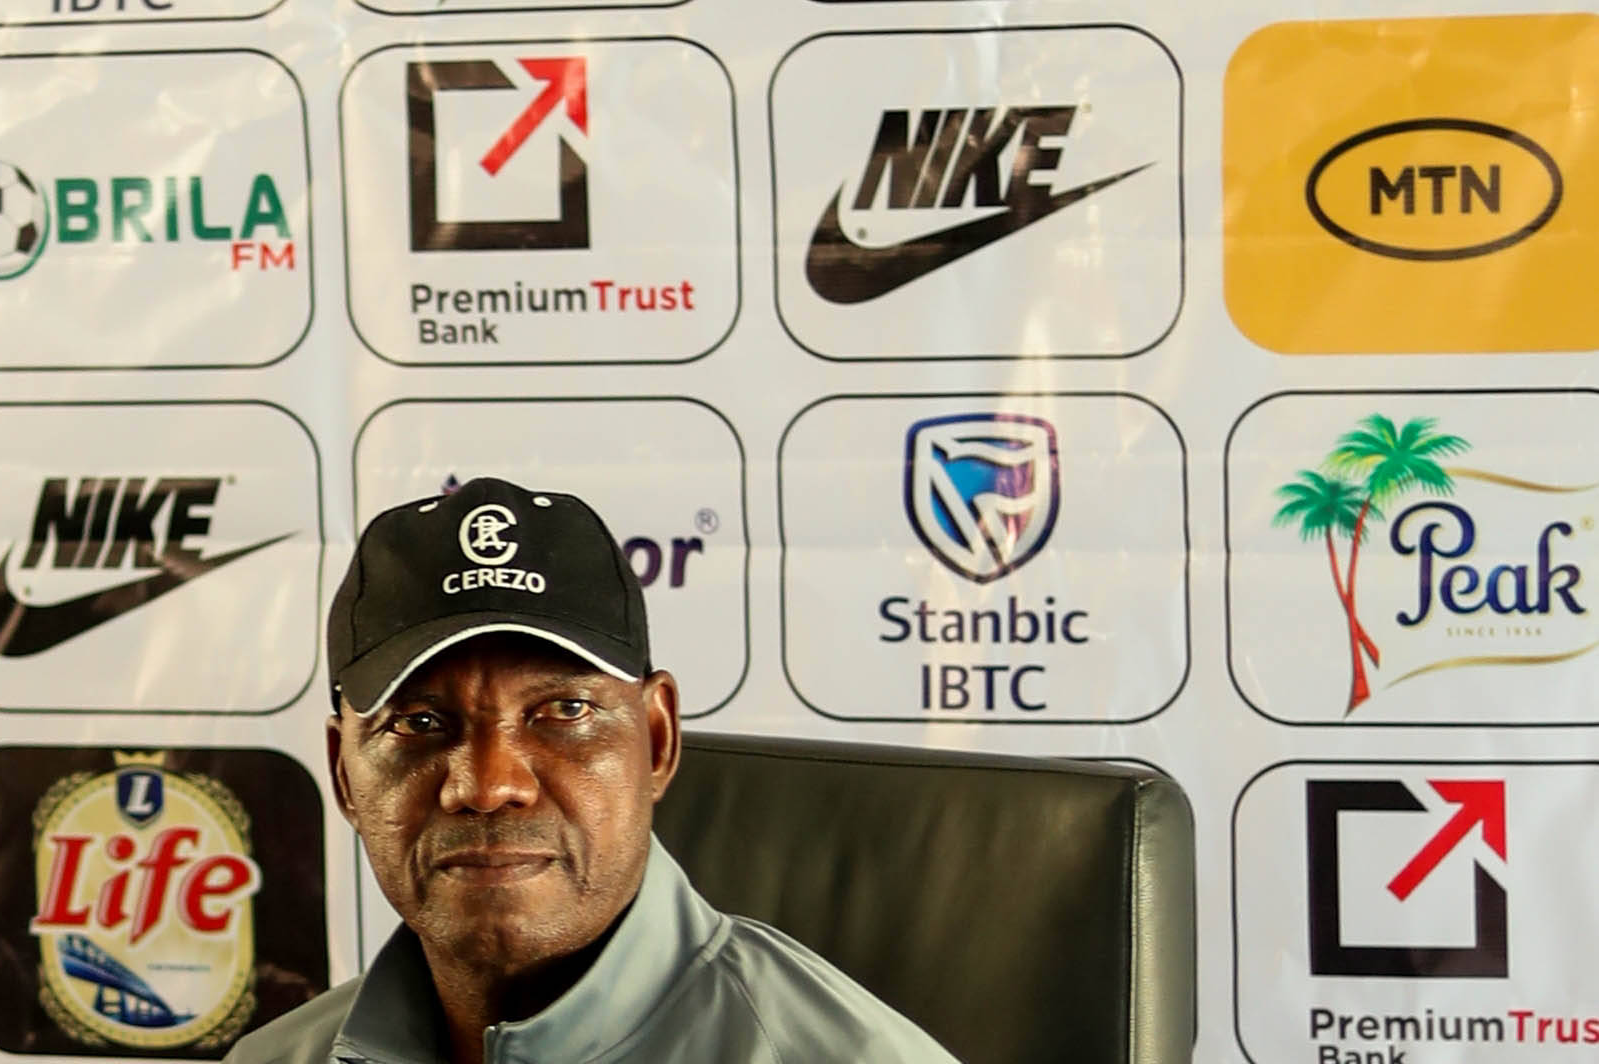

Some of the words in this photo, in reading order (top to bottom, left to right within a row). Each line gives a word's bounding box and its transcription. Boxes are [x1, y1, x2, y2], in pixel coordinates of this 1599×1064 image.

[852, 105, 1078, 210] NIKE
[56, 174, 290, 242] BRILA
[1368, 166, 1501, 215] MTN
[232, 243, 296, 270] FM
[411, 281, 694, 314] PremiumTrust
[420, 319, 498, 344] Bank
[21, 477, 222, 570] NIKE
[443, 568, 546, 594] CEREZO
[1391, 501, 1586, 626] Peak
[880, 597, 1089, 644] Stanbic
[920, 664, 1046, 711] IBTC
[31, 826, 260, 946] Life
[1310, 1009, 1599, 1045] PremiumTrus
